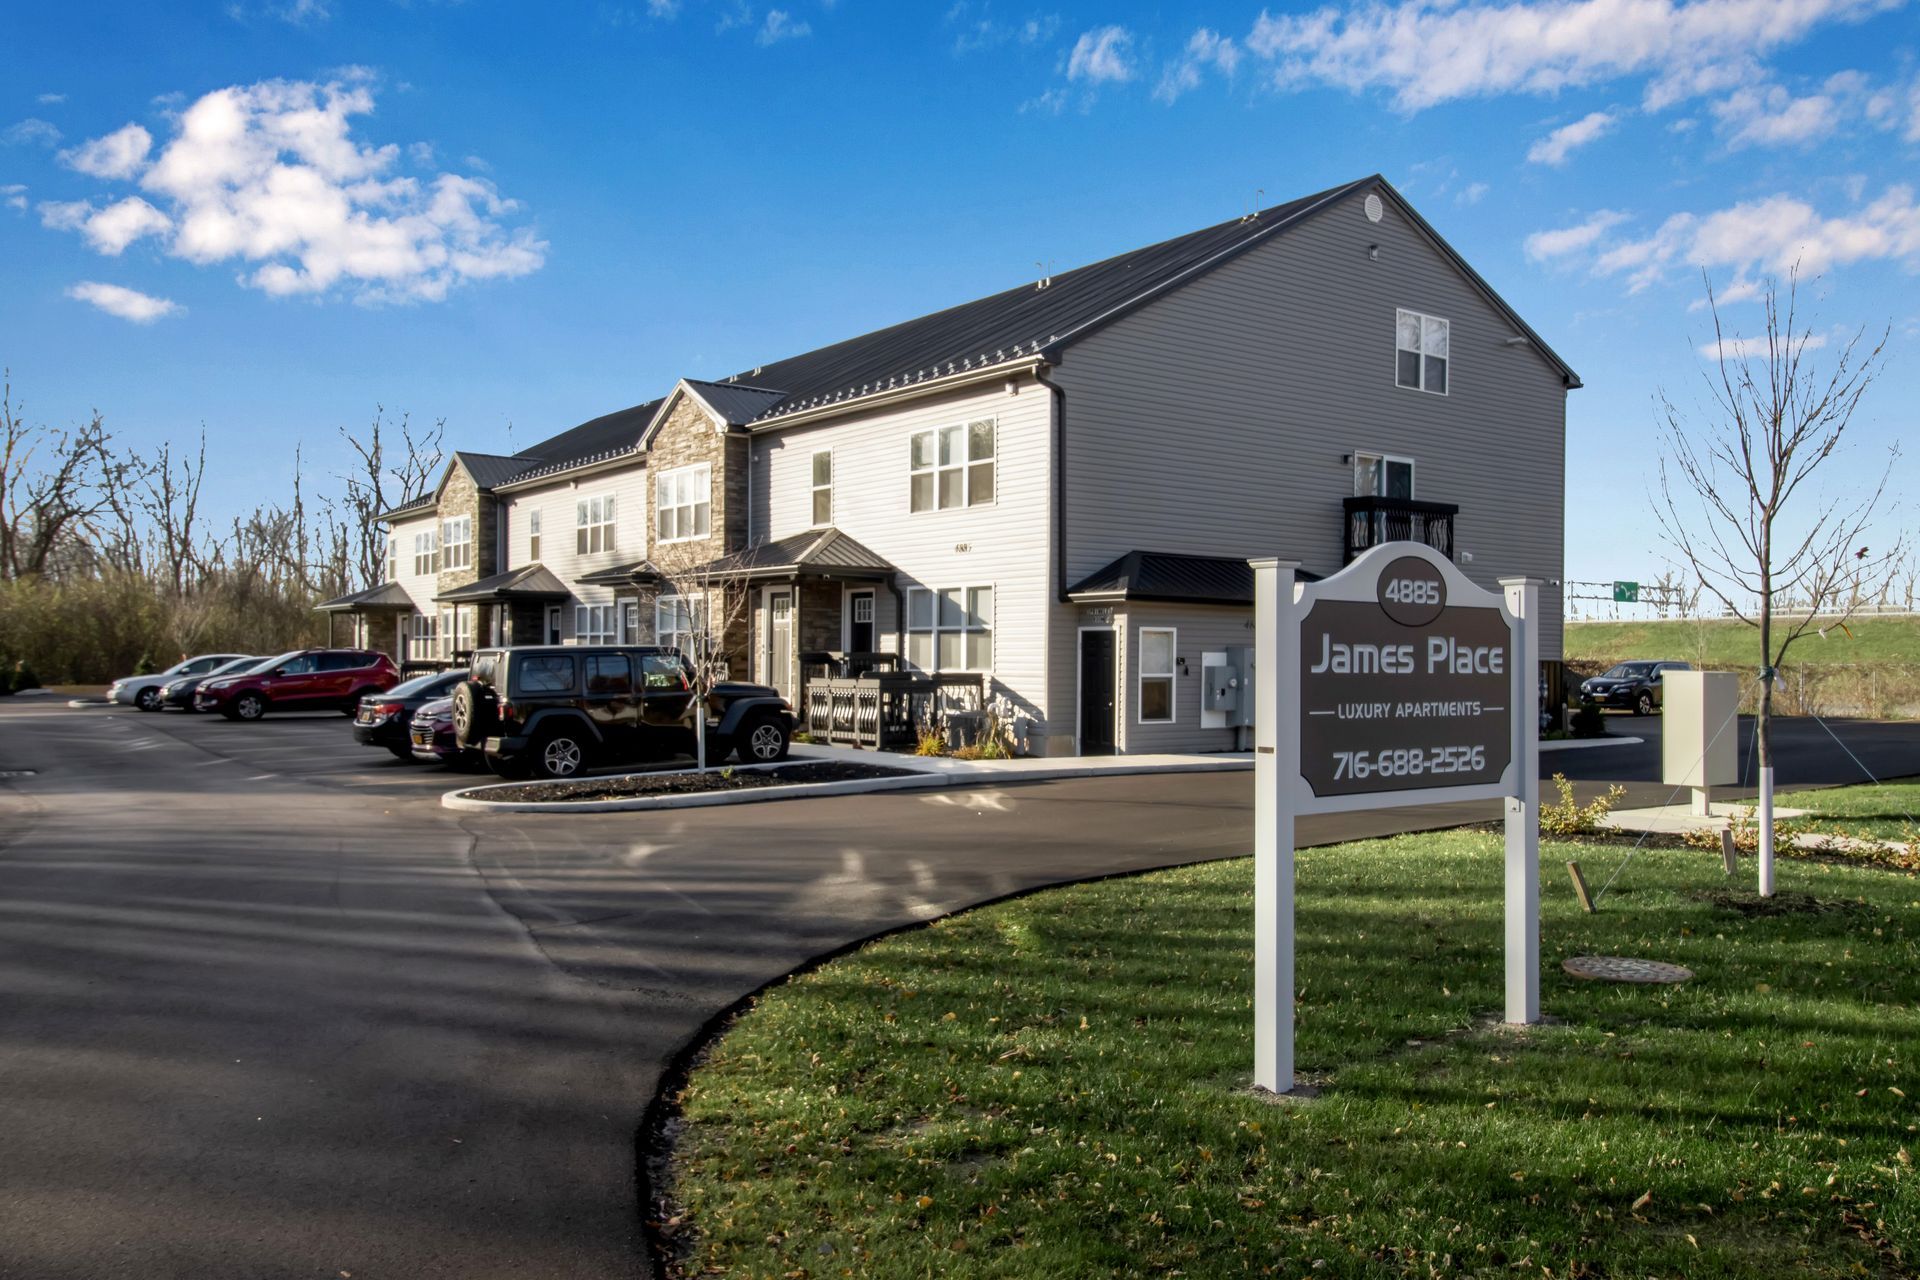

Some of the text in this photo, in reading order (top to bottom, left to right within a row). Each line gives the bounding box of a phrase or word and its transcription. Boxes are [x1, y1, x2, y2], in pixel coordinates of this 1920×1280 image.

[1385, 579, 1440, 604] 4885
[1311, 633, 1503, 674] James Place
[1338, 701, 1481, 719] LUXURY APARTMENTS
[1333, 746, 1485, 780] 716-688-2526
